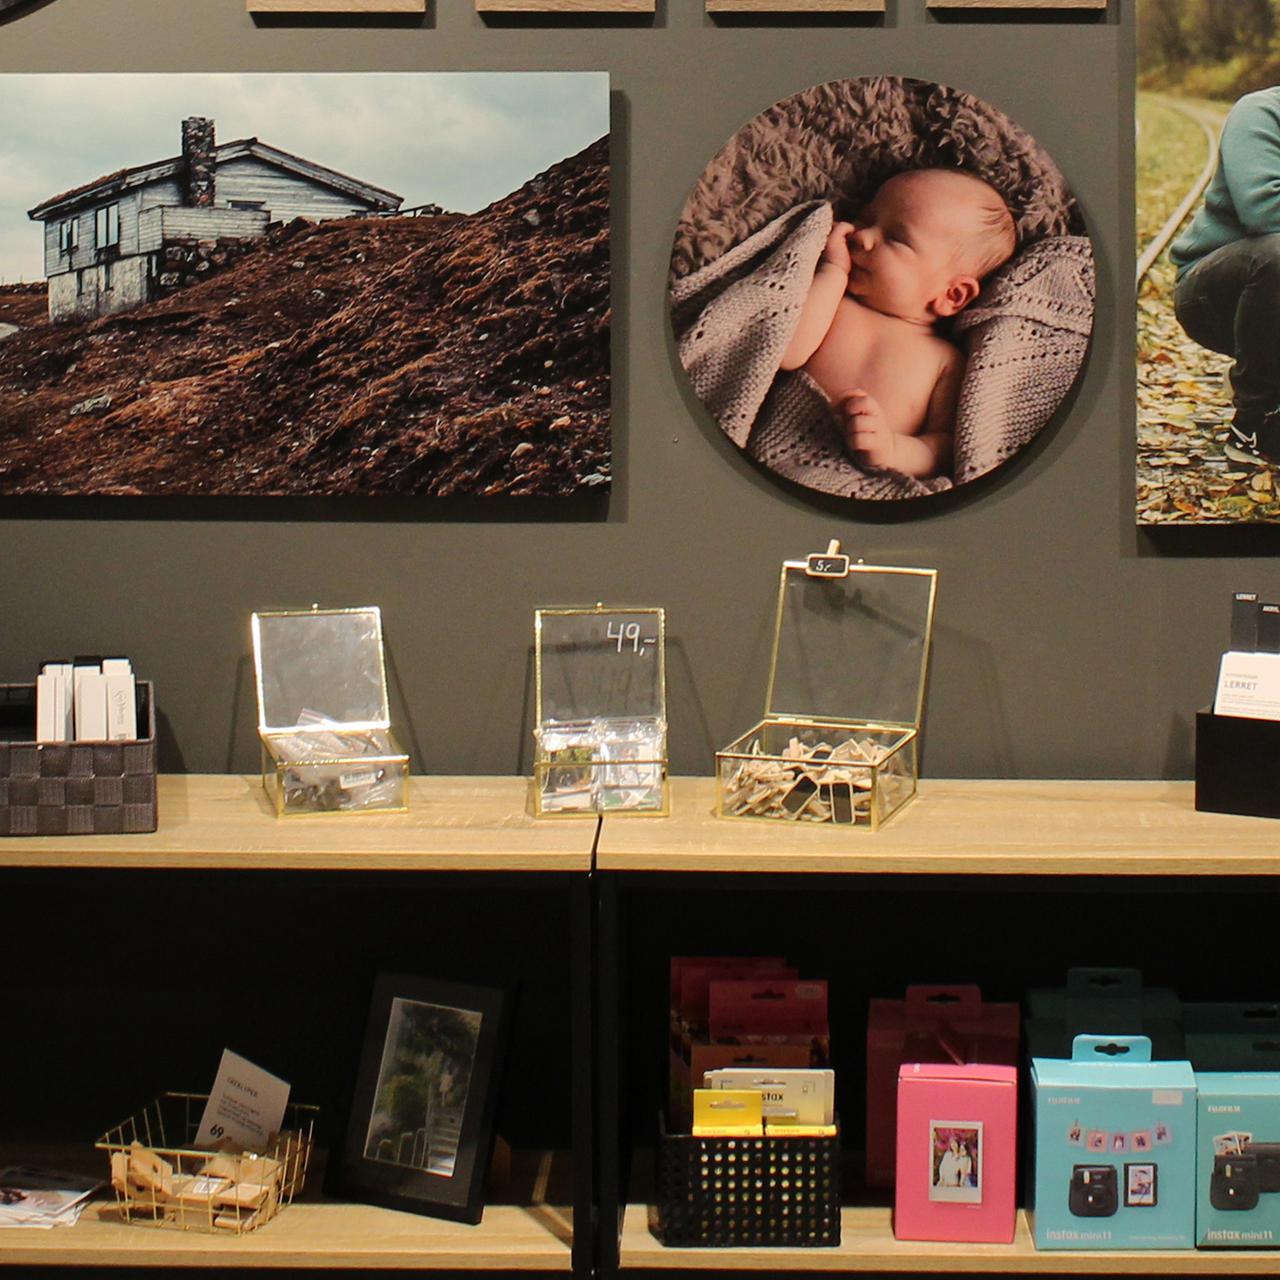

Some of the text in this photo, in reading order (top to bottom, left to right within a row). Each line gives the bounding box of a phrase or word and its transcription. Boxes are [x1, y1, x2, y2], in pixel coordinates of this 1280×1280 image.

[1235, 593, 1257, 601] LERRET
[606, 621, 658, 658] 49,-
[1224, 681, 1258, 691] LERRET
[1207, 1105, 1241, 1113] FUJIFILM
[210, 1123, 224, 1139] 69
[1046, 1228, 1112, 1241] instax mini 11
[1207, 1227, 1273, 1241] instax mini 11
